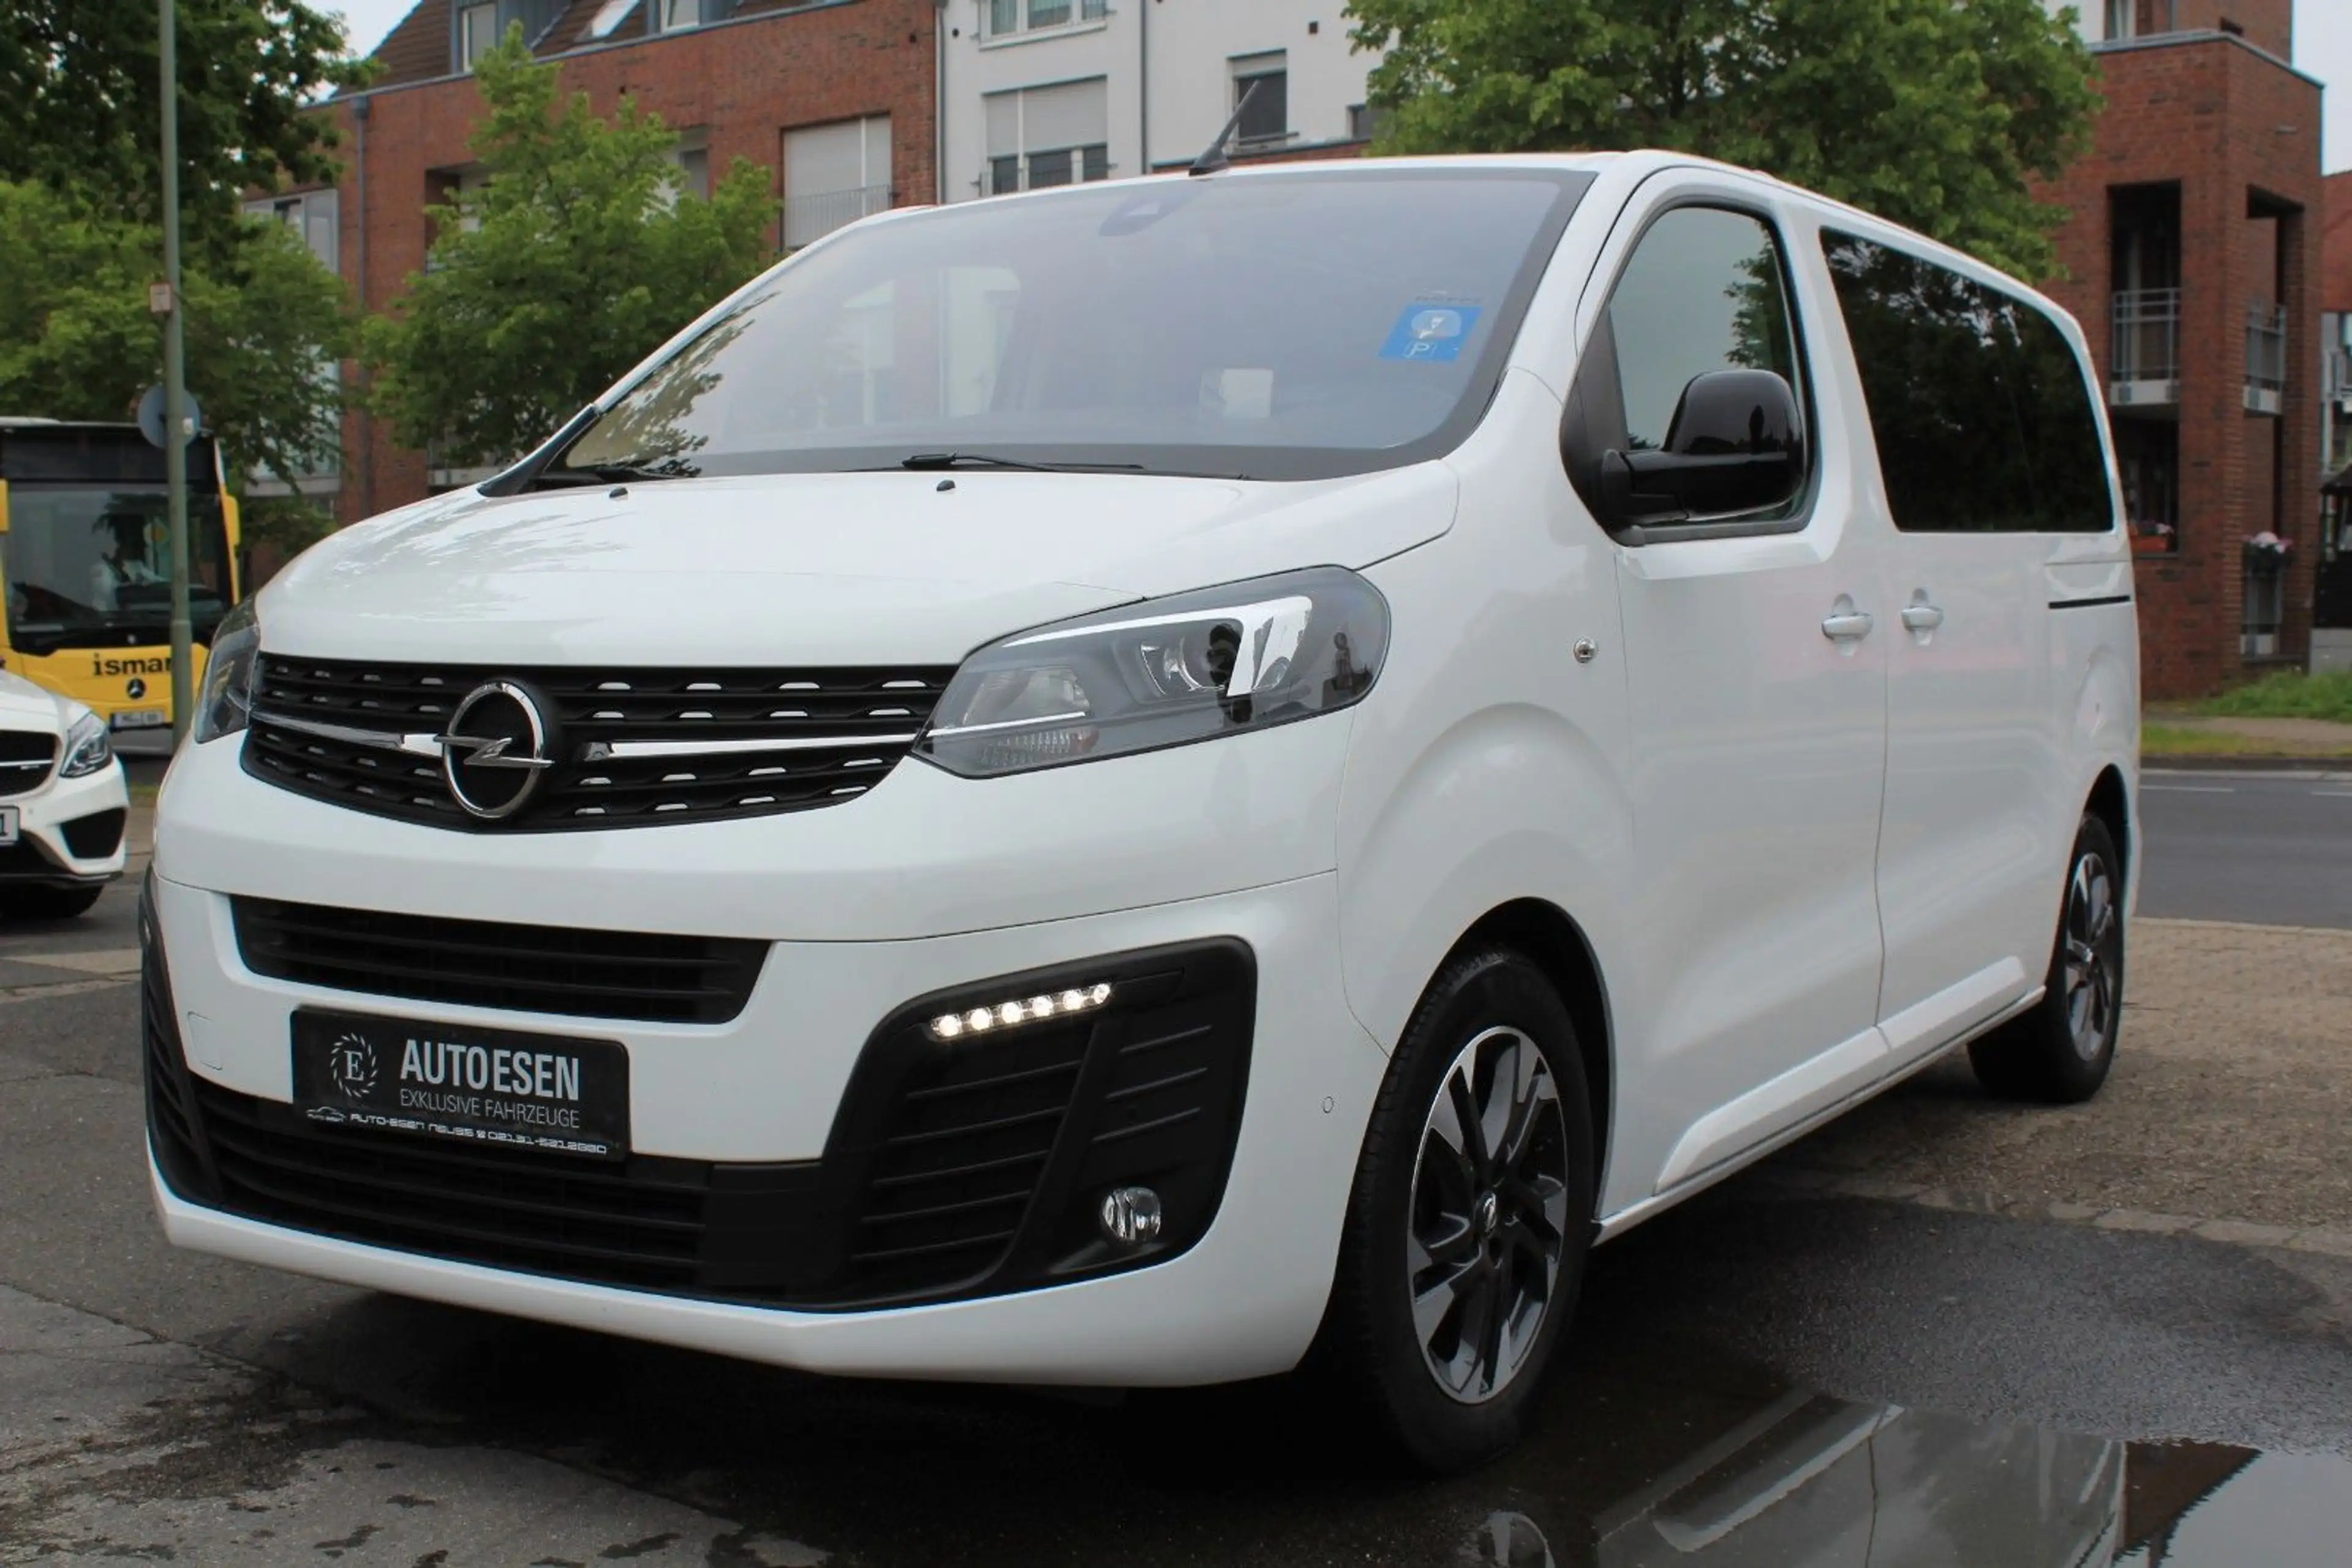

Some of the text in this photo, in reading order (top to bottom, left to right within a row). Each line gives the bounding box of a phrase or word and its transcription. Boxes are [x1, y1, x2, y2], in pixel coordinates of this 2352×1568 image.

[344, 1050, 364, 1081] E
[400, 1039, 579, 1101] AUTOESEN
[400, 1088, 581, 1129] EXKLUSIVE FAHRZEUGE
